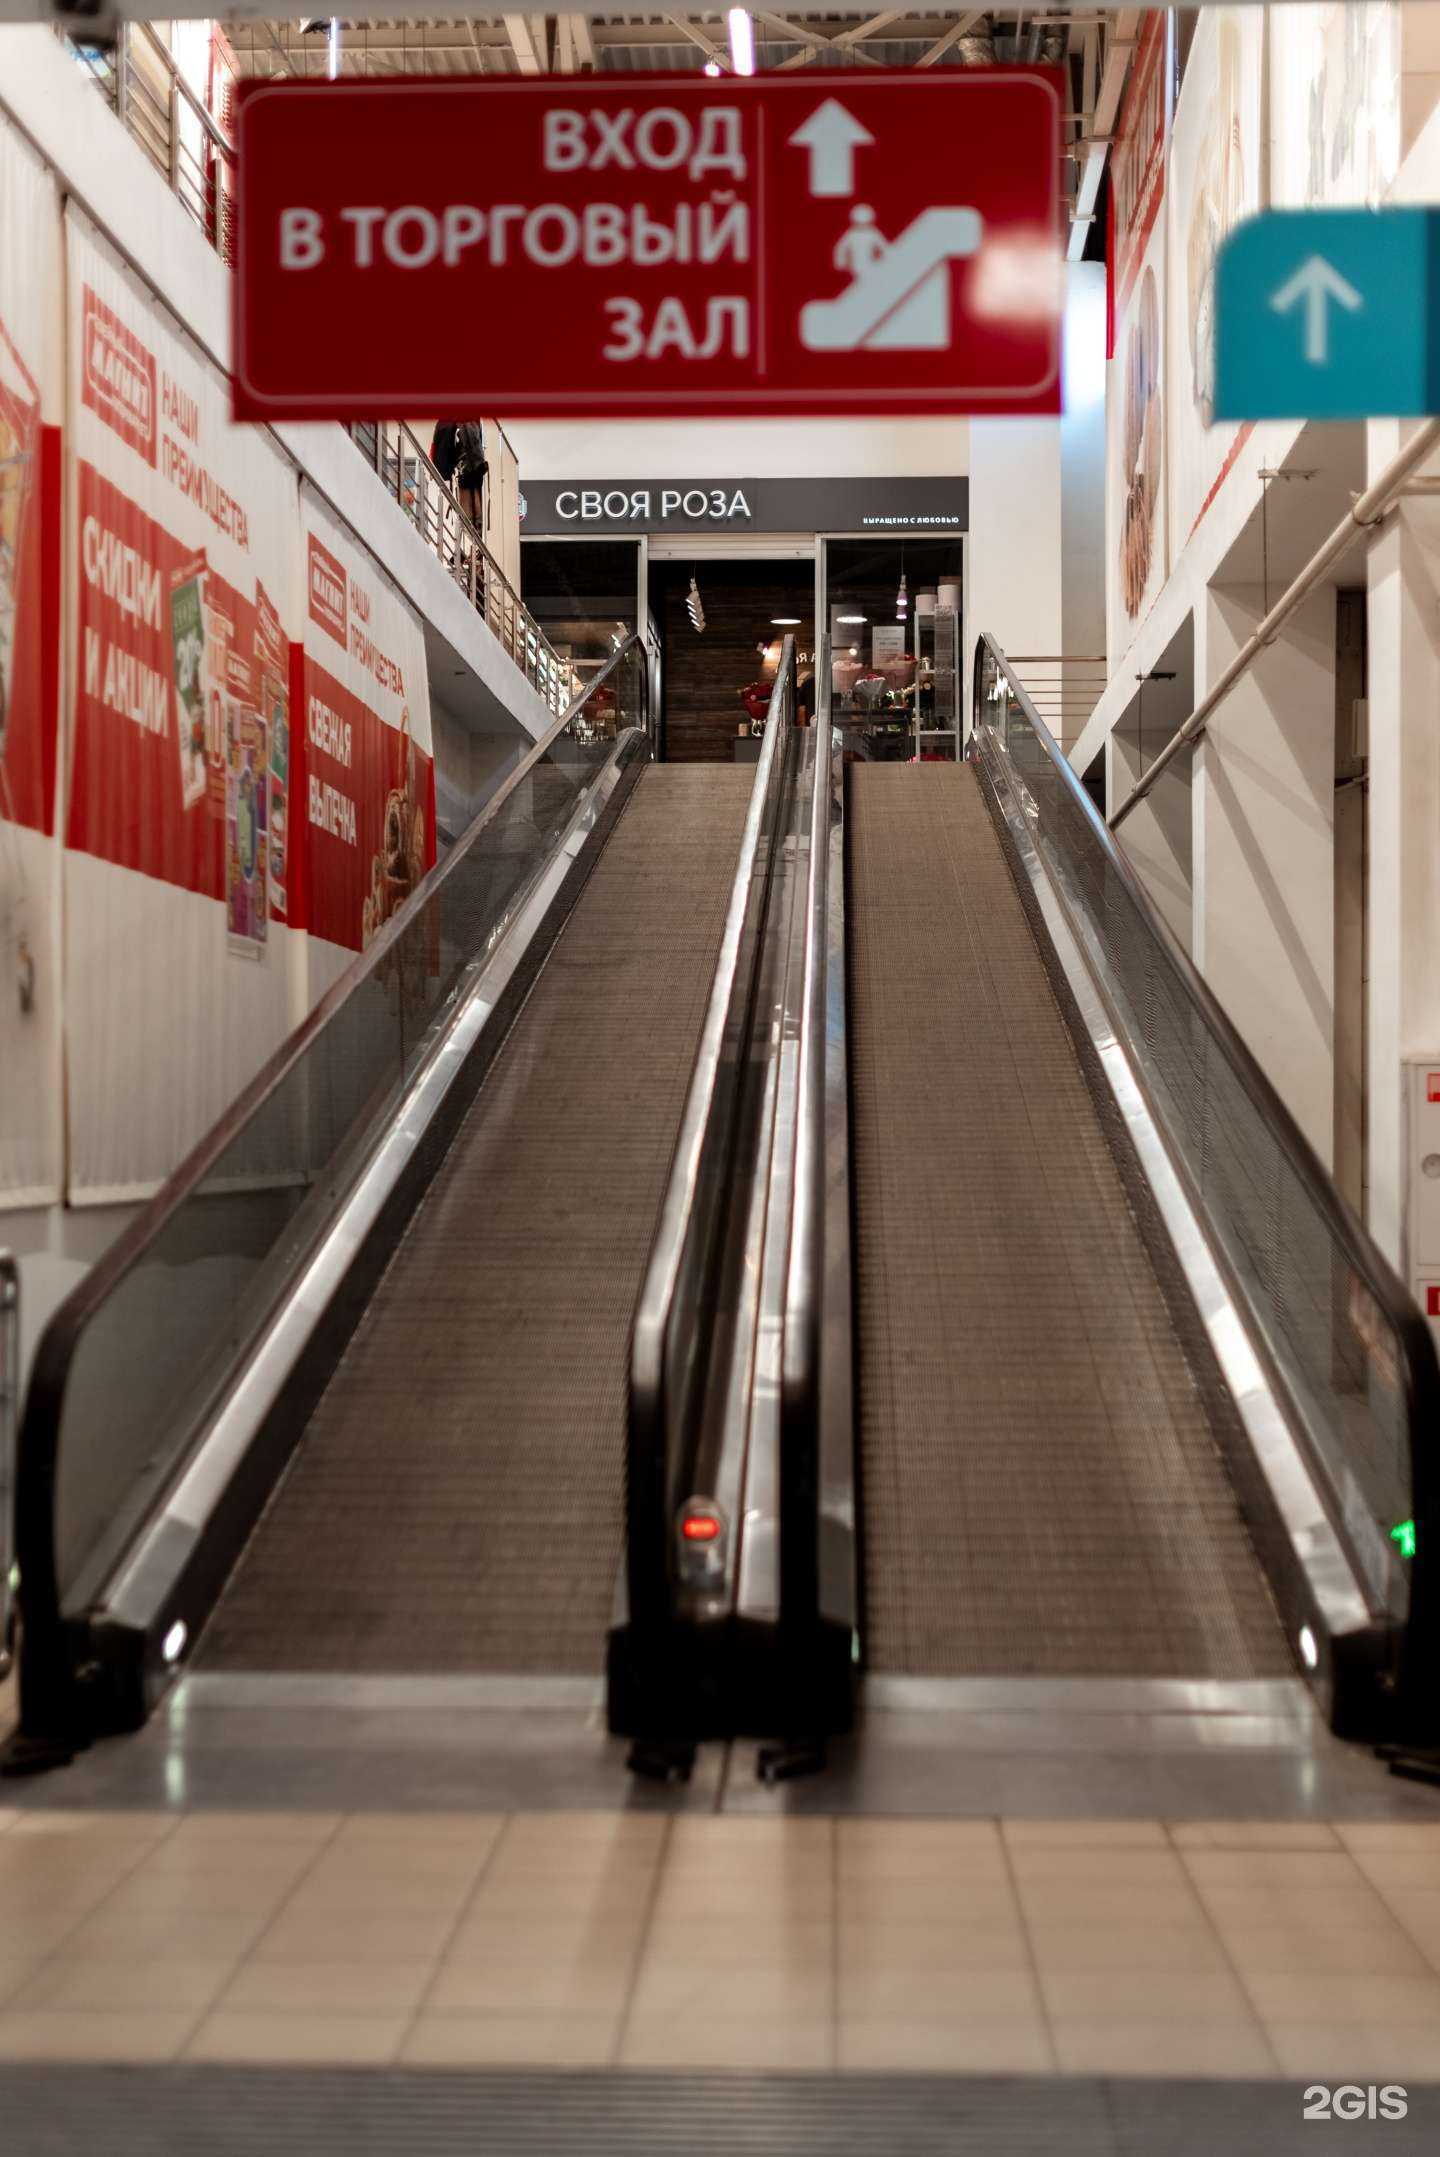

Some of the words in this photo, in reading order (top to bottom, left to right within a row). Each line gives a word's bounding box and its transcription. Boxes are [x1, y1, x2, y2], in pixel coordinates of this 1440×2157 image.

[543, 107, 746, 182] ВХОД
[279, 207, 325, 269] В
[340, 191, 750, 269] ТОРГОВЫЙ
[603, 296, 750, 361] ЗАЛ
[162, 370, 199, 446] НАШИ
[162, 433, 249, 553] ПРЕИМУЩЕСТВА
[555, 491, 650, 519] СВОЯ
[661, 489, 752, 518] РОЗА
[863, 517, 908, 525] ВЫРАЩЕНО
[917, 516, 960, 524] ЛЮБОВЬЮ
[83, 515, 161, 632] СКИДКИ
[85, 626, 99, 699] И
[103, 642, 168, 738] АКЦИИ
[308, 695, 351, 768] СВЕЖАЯ
[309, 774, 357, 847] ВЫПЕЧКА
